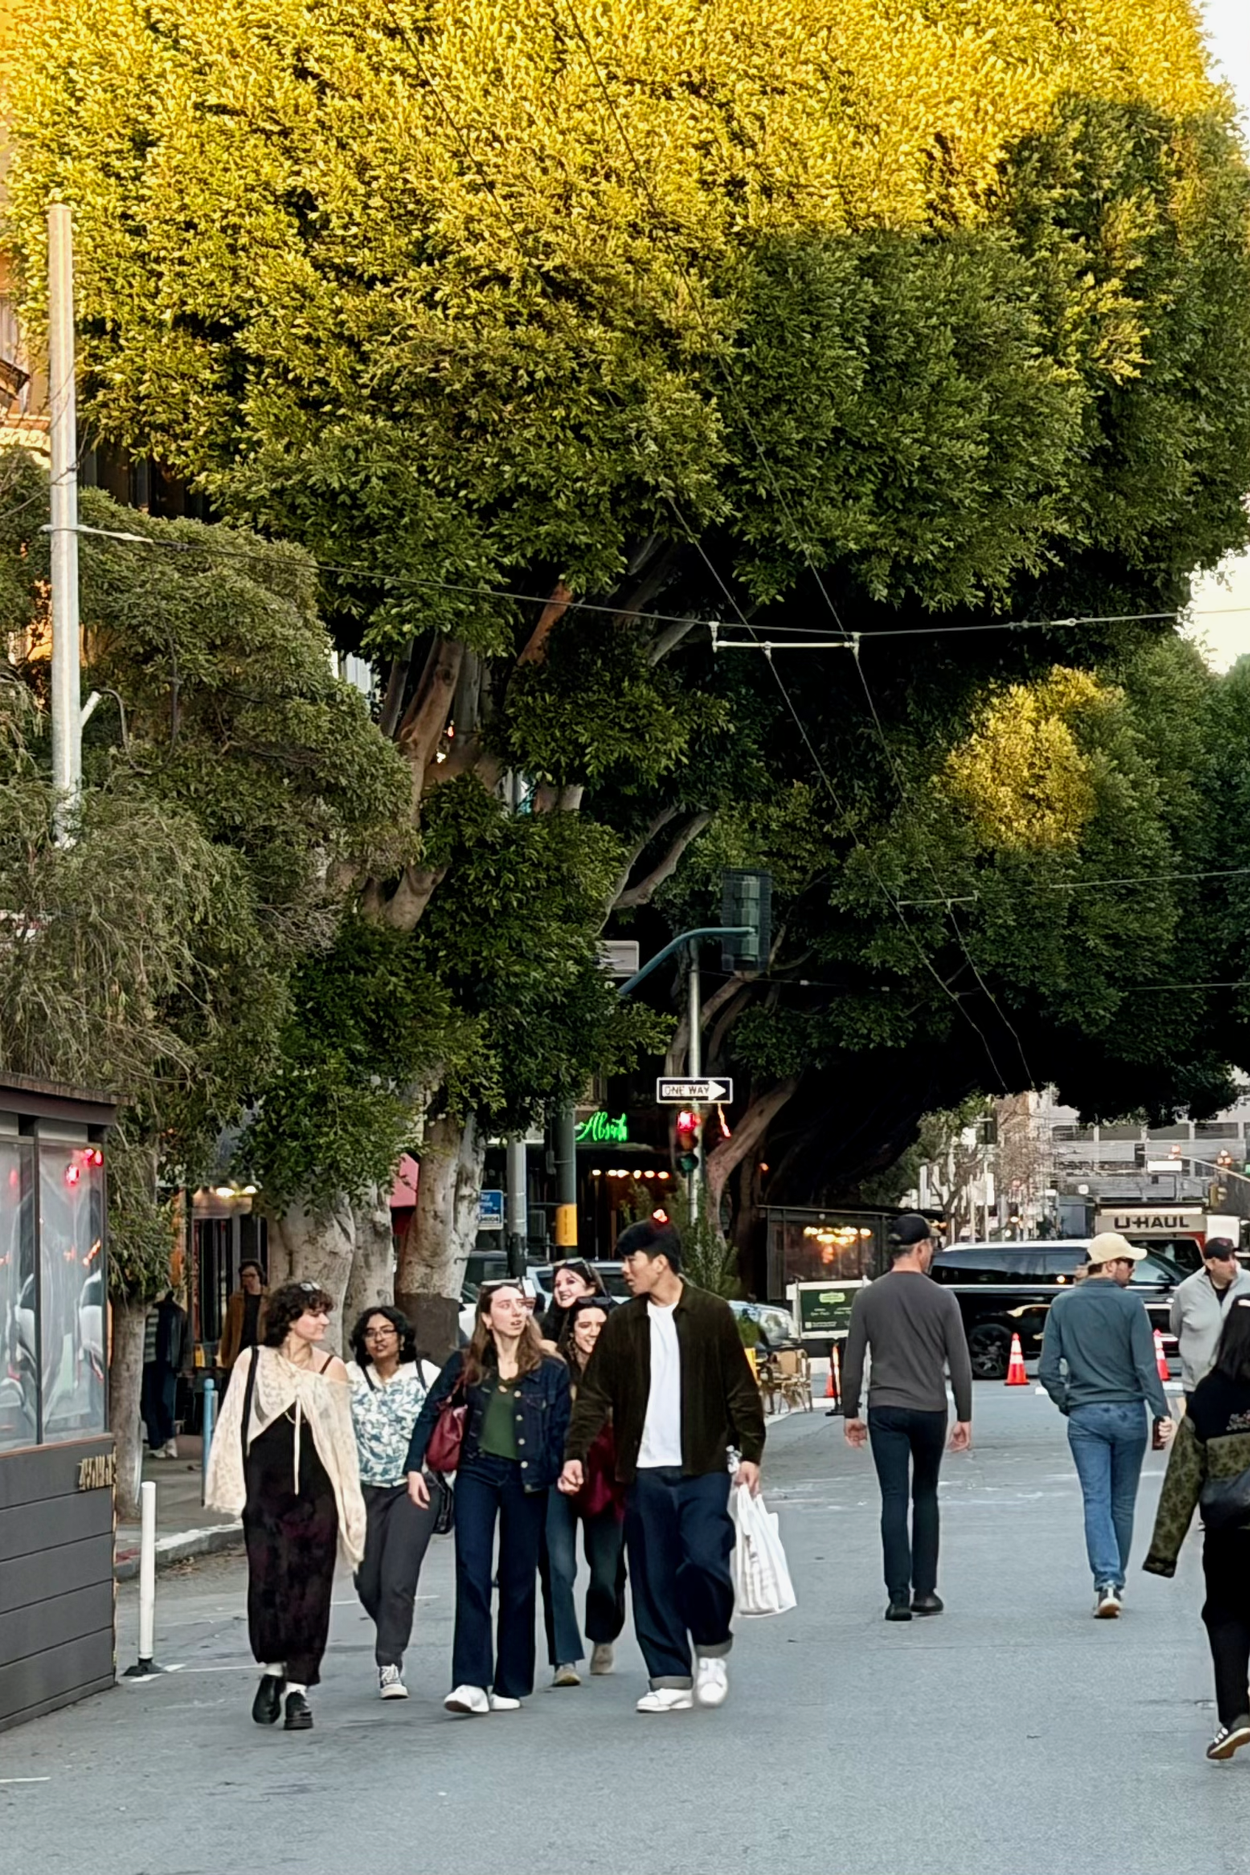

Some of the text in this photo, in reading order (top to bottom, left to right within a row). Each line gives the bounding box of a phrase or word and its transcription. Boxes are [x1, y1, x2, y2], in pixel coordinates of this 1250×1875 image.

[664, 1085, 709, 1096] ONE WAY
[1113, 1215, 1190, 1229] U-HAUL
